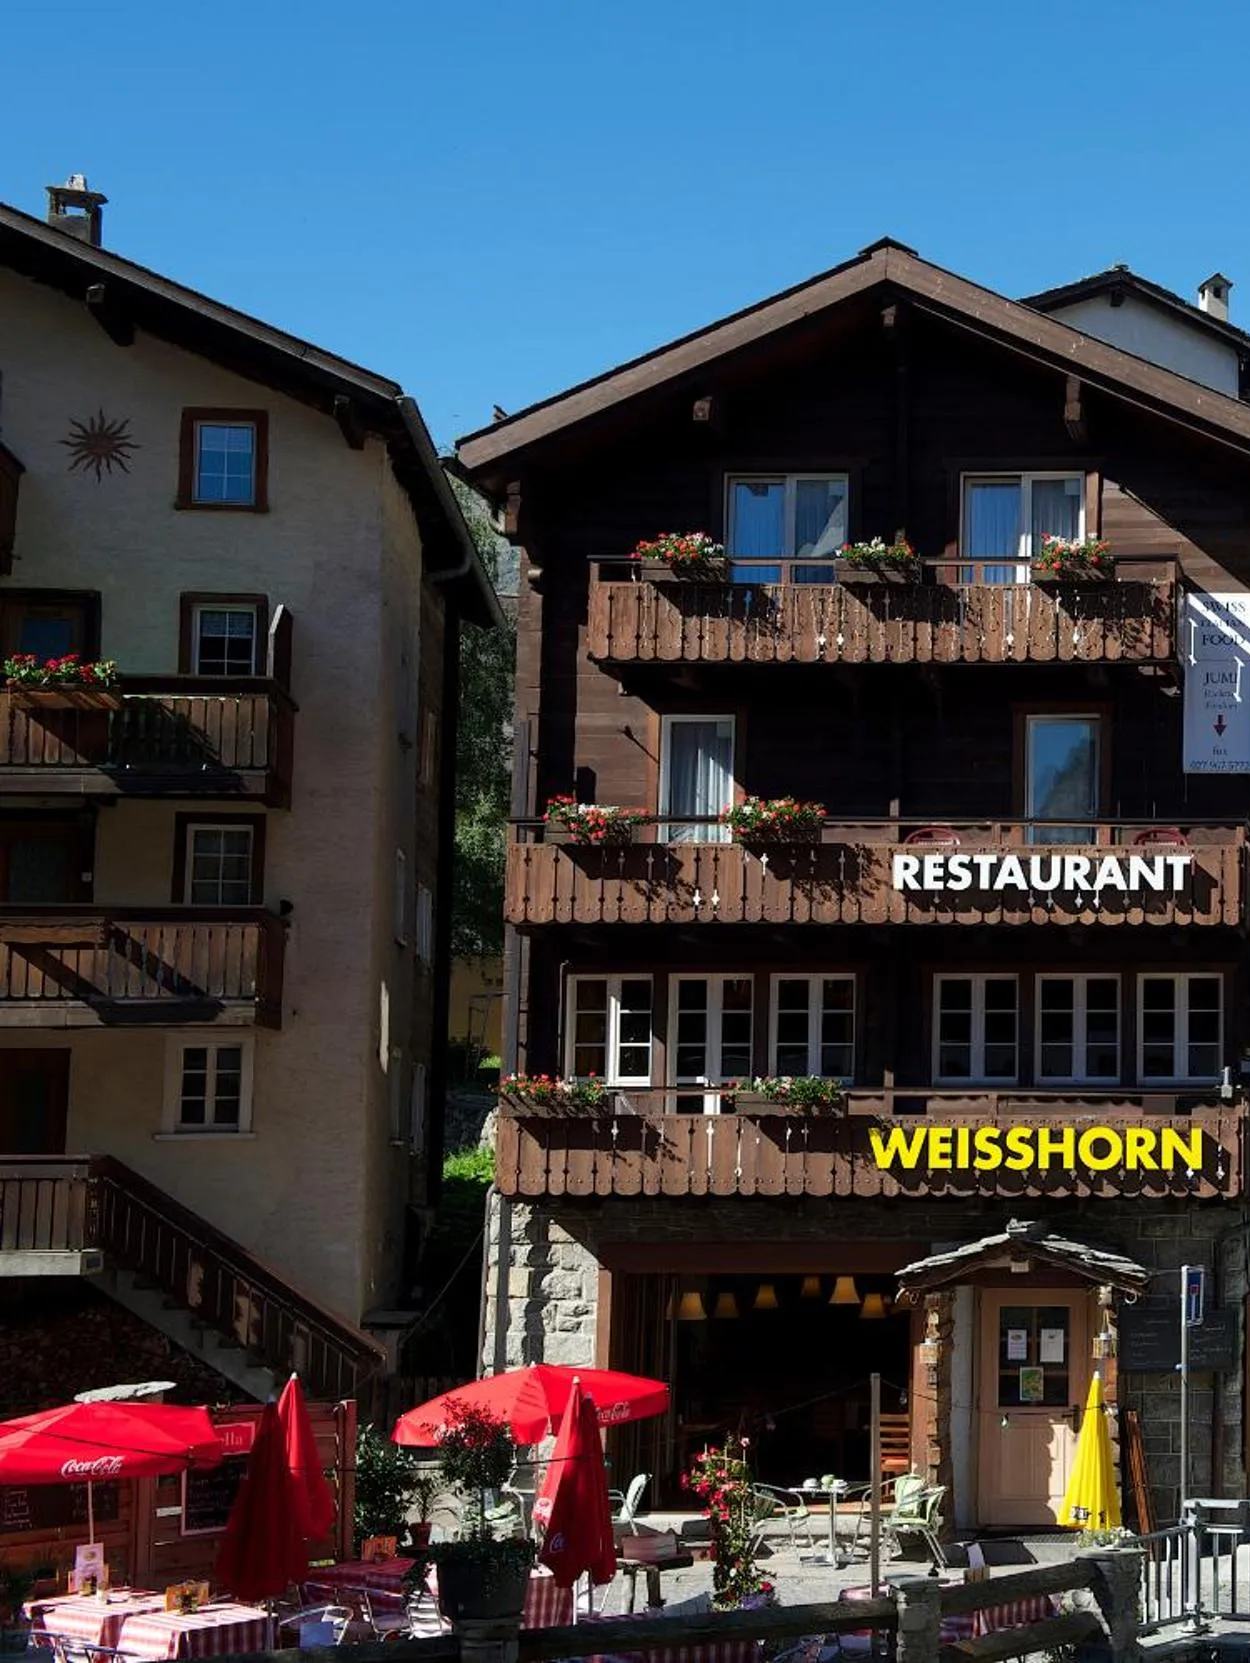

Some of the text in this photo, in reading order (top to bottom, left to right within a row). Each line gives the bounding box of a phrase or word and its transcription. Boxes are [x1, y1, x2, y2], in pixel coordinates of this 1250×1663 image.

[1203, 600, 1247, 613] SWISS
[1202, 634, 1246, 646] FOOD
[892, 853, 1193, 892] RESTAURANT
[868, 1126, 1203, 1171] WEISSHORN
[594, 1401, 631, 1423] oca-Cola
[60, 1456, 126, 1479] Coca-Cola
